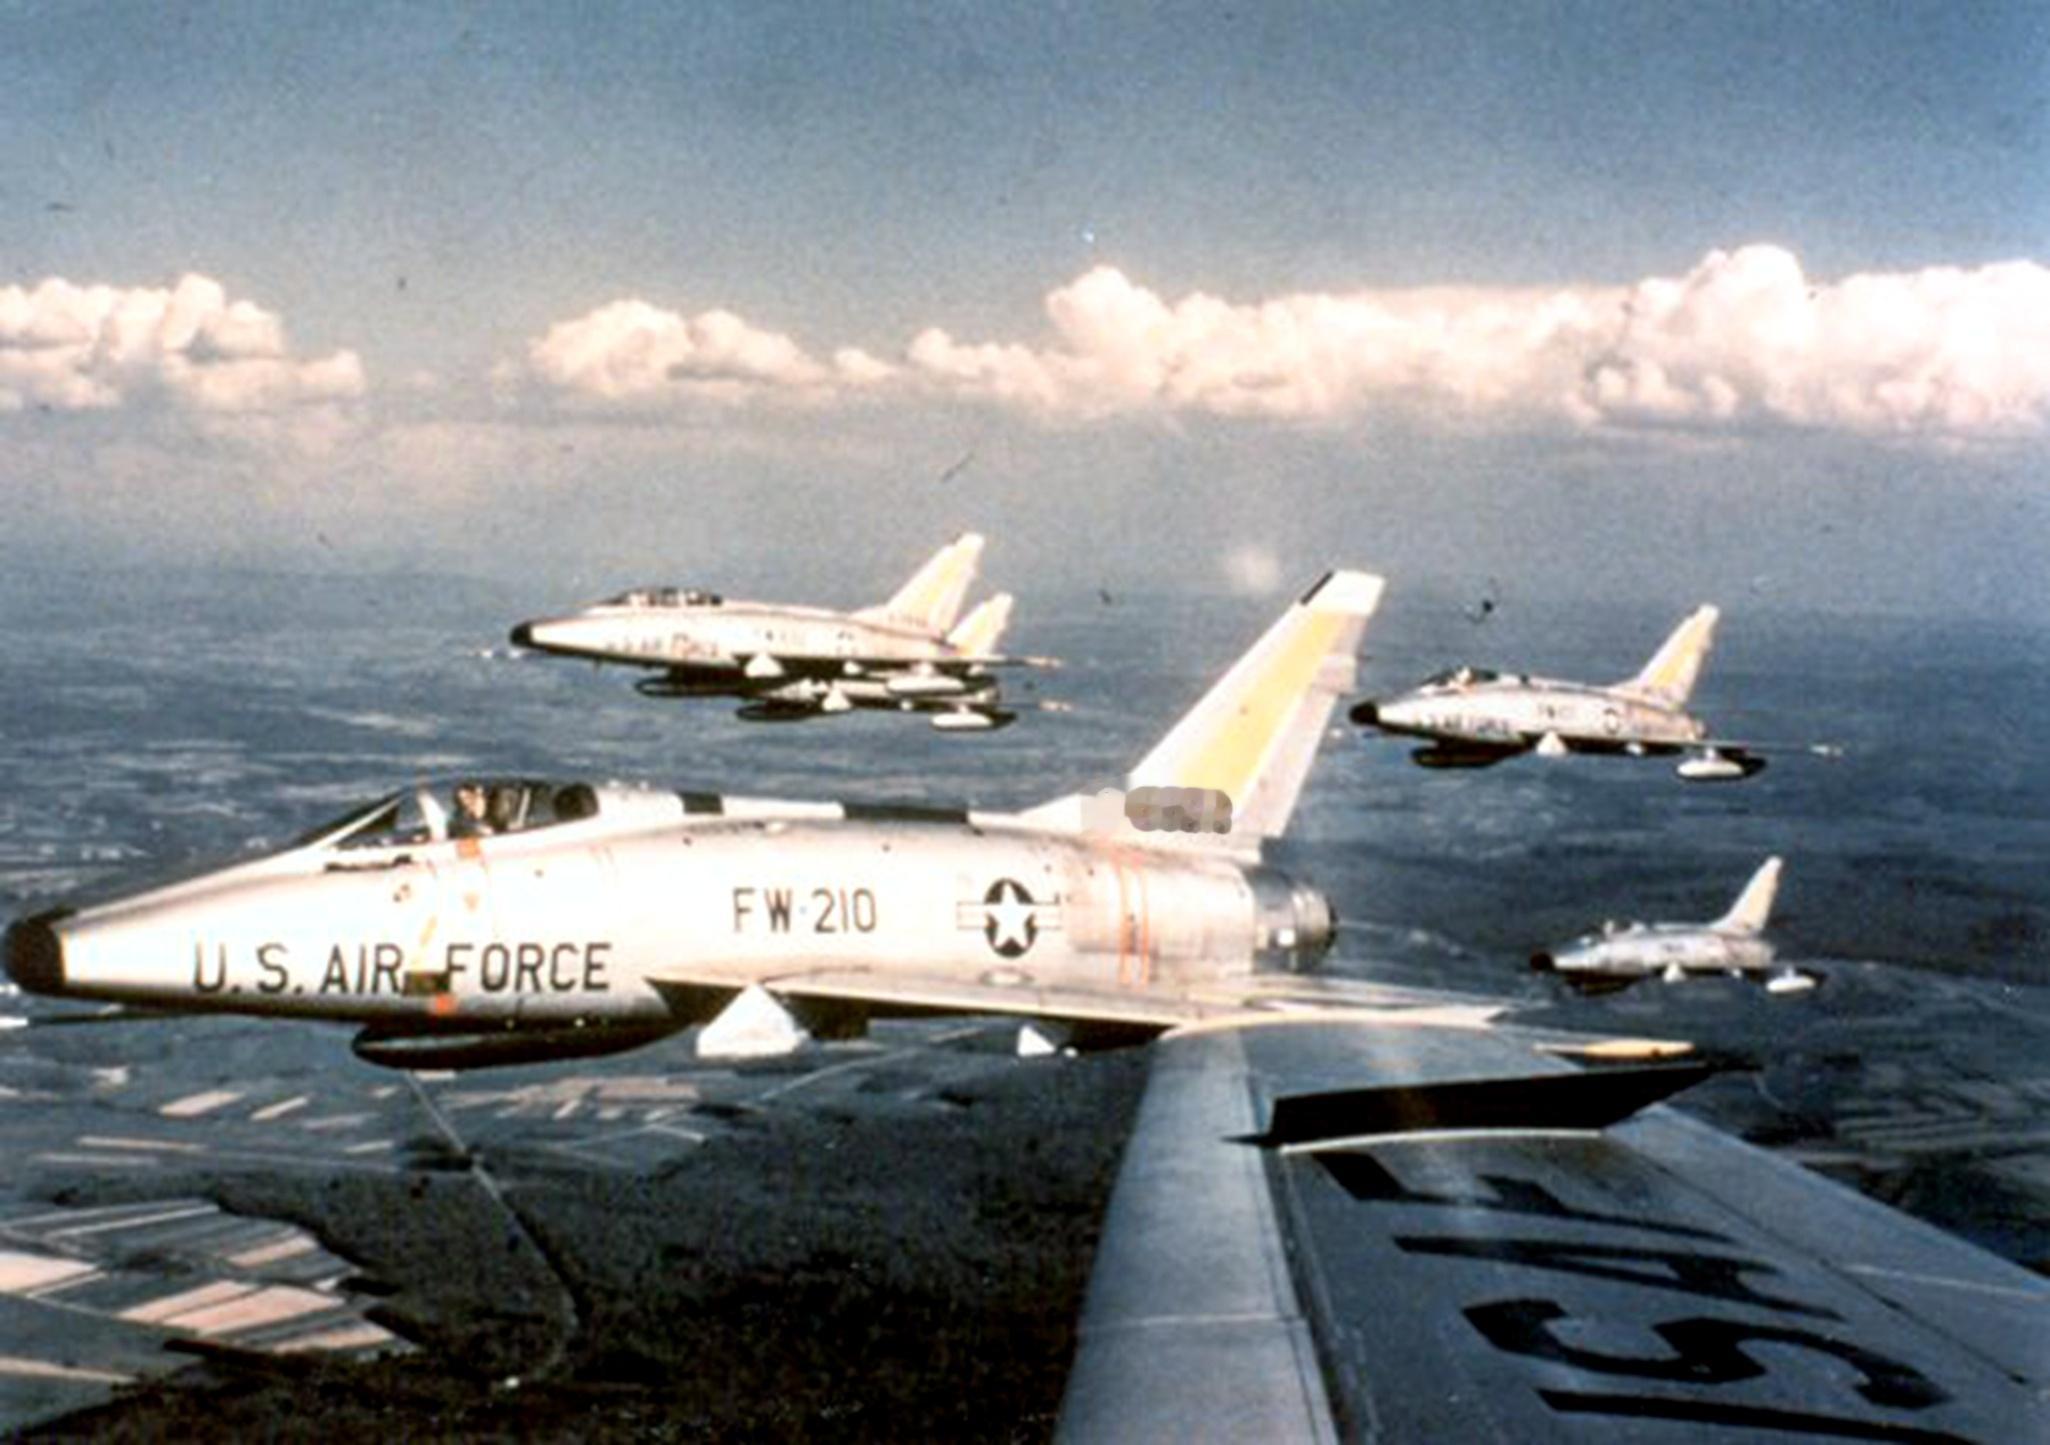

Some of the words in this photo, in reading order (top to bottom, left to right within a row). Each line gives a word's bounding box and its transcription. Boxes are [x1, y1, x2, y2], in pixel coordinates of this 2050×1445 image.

[193, 942, 304, 994] U.S.
[319, 943, 404, 994] AIR
[446, 942, 612, 993] FORCE
